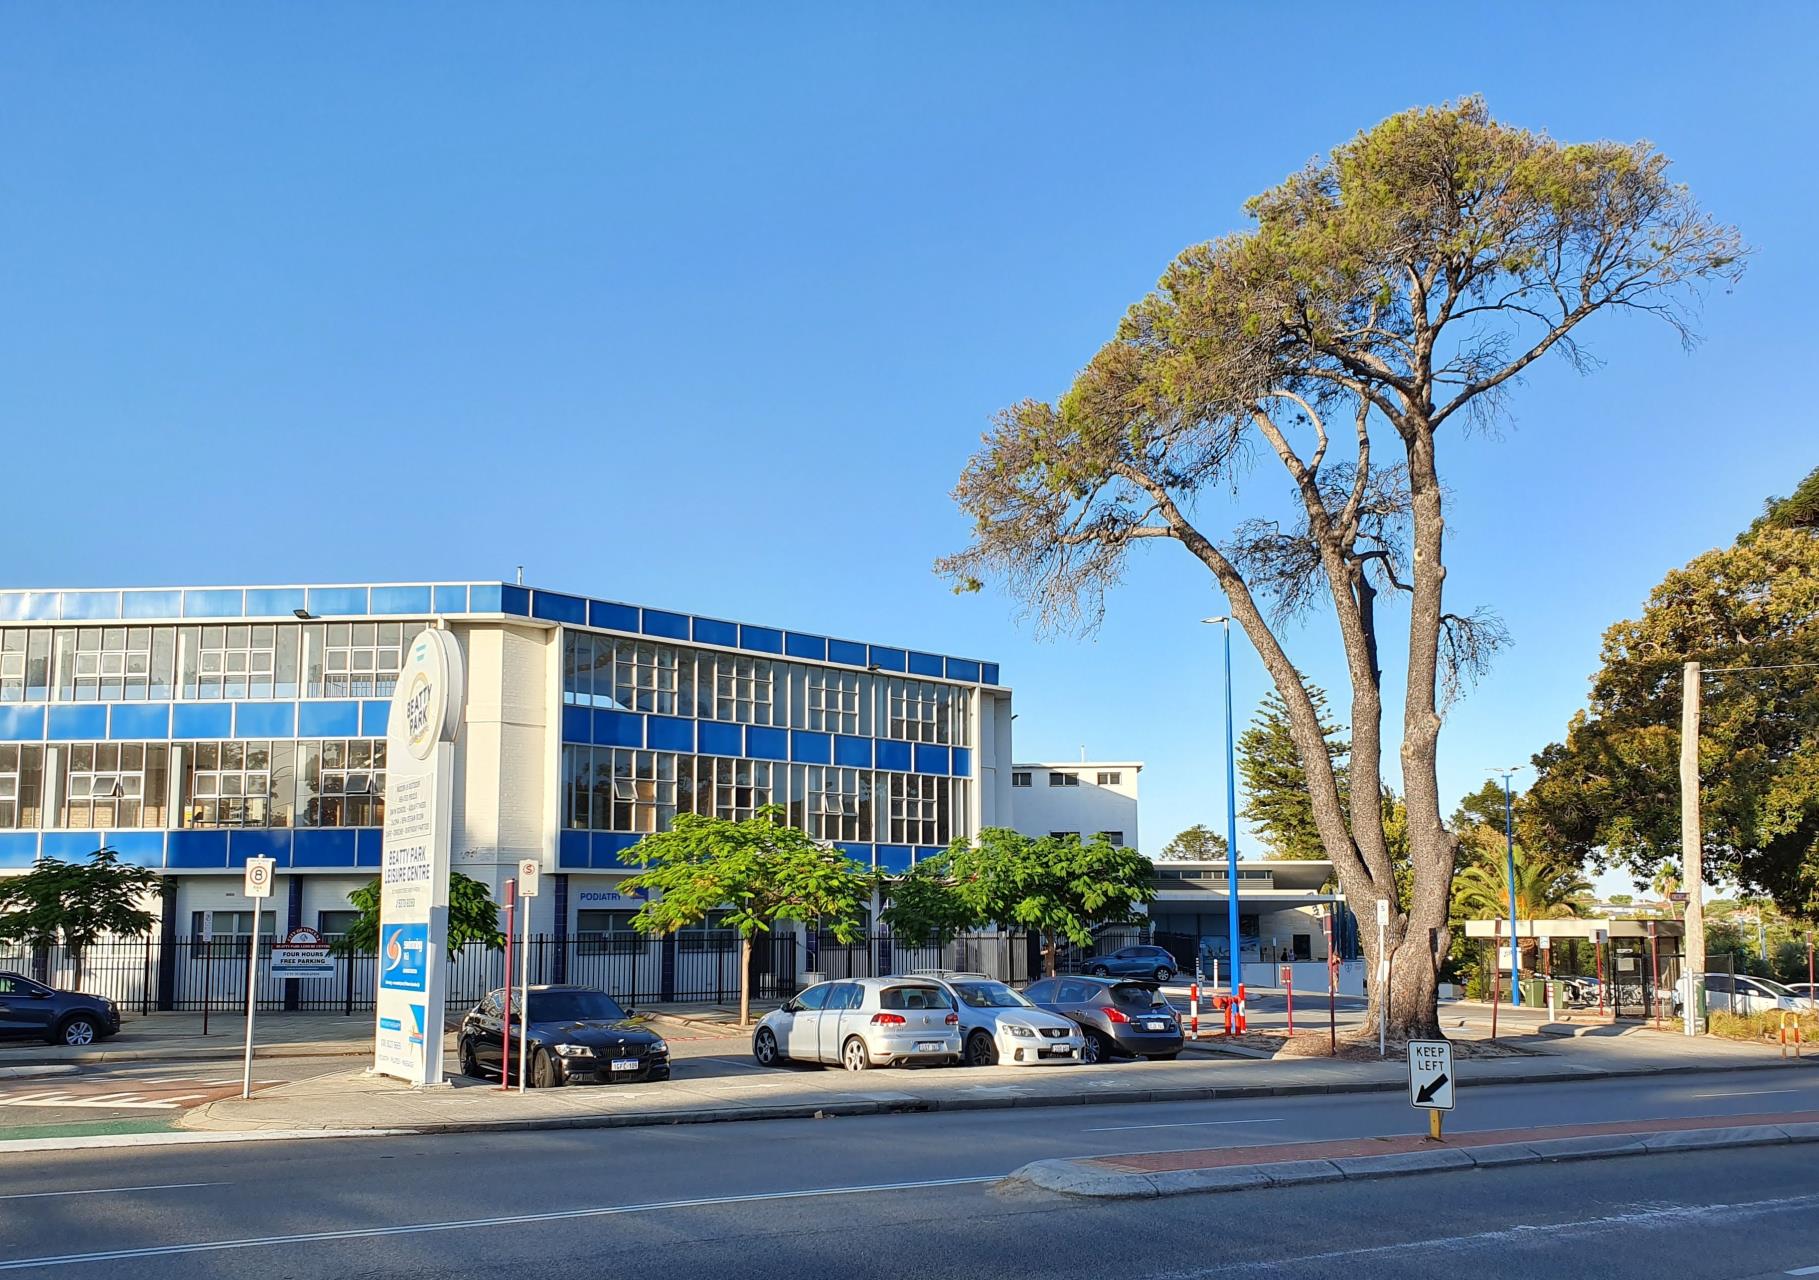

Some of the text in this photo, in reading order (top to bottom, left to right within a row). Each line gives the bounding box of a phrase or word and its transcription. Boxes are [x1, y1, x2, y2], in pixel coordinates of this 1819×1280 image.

[407, 683, 432, 720] BEATTY
[409, 705, 428, 736] PARK
[388, 844, 426, 866] BEATTY PARK
[255, 870, 263, 881] 8
[384, 864, 430, 884] LEISURE CENTRE
[580, 892, 621, 901] PODIATRY
[1416, 1046, 1444, 1057] KEEP
[1418, 1060, 1444, 1071] LEFT
